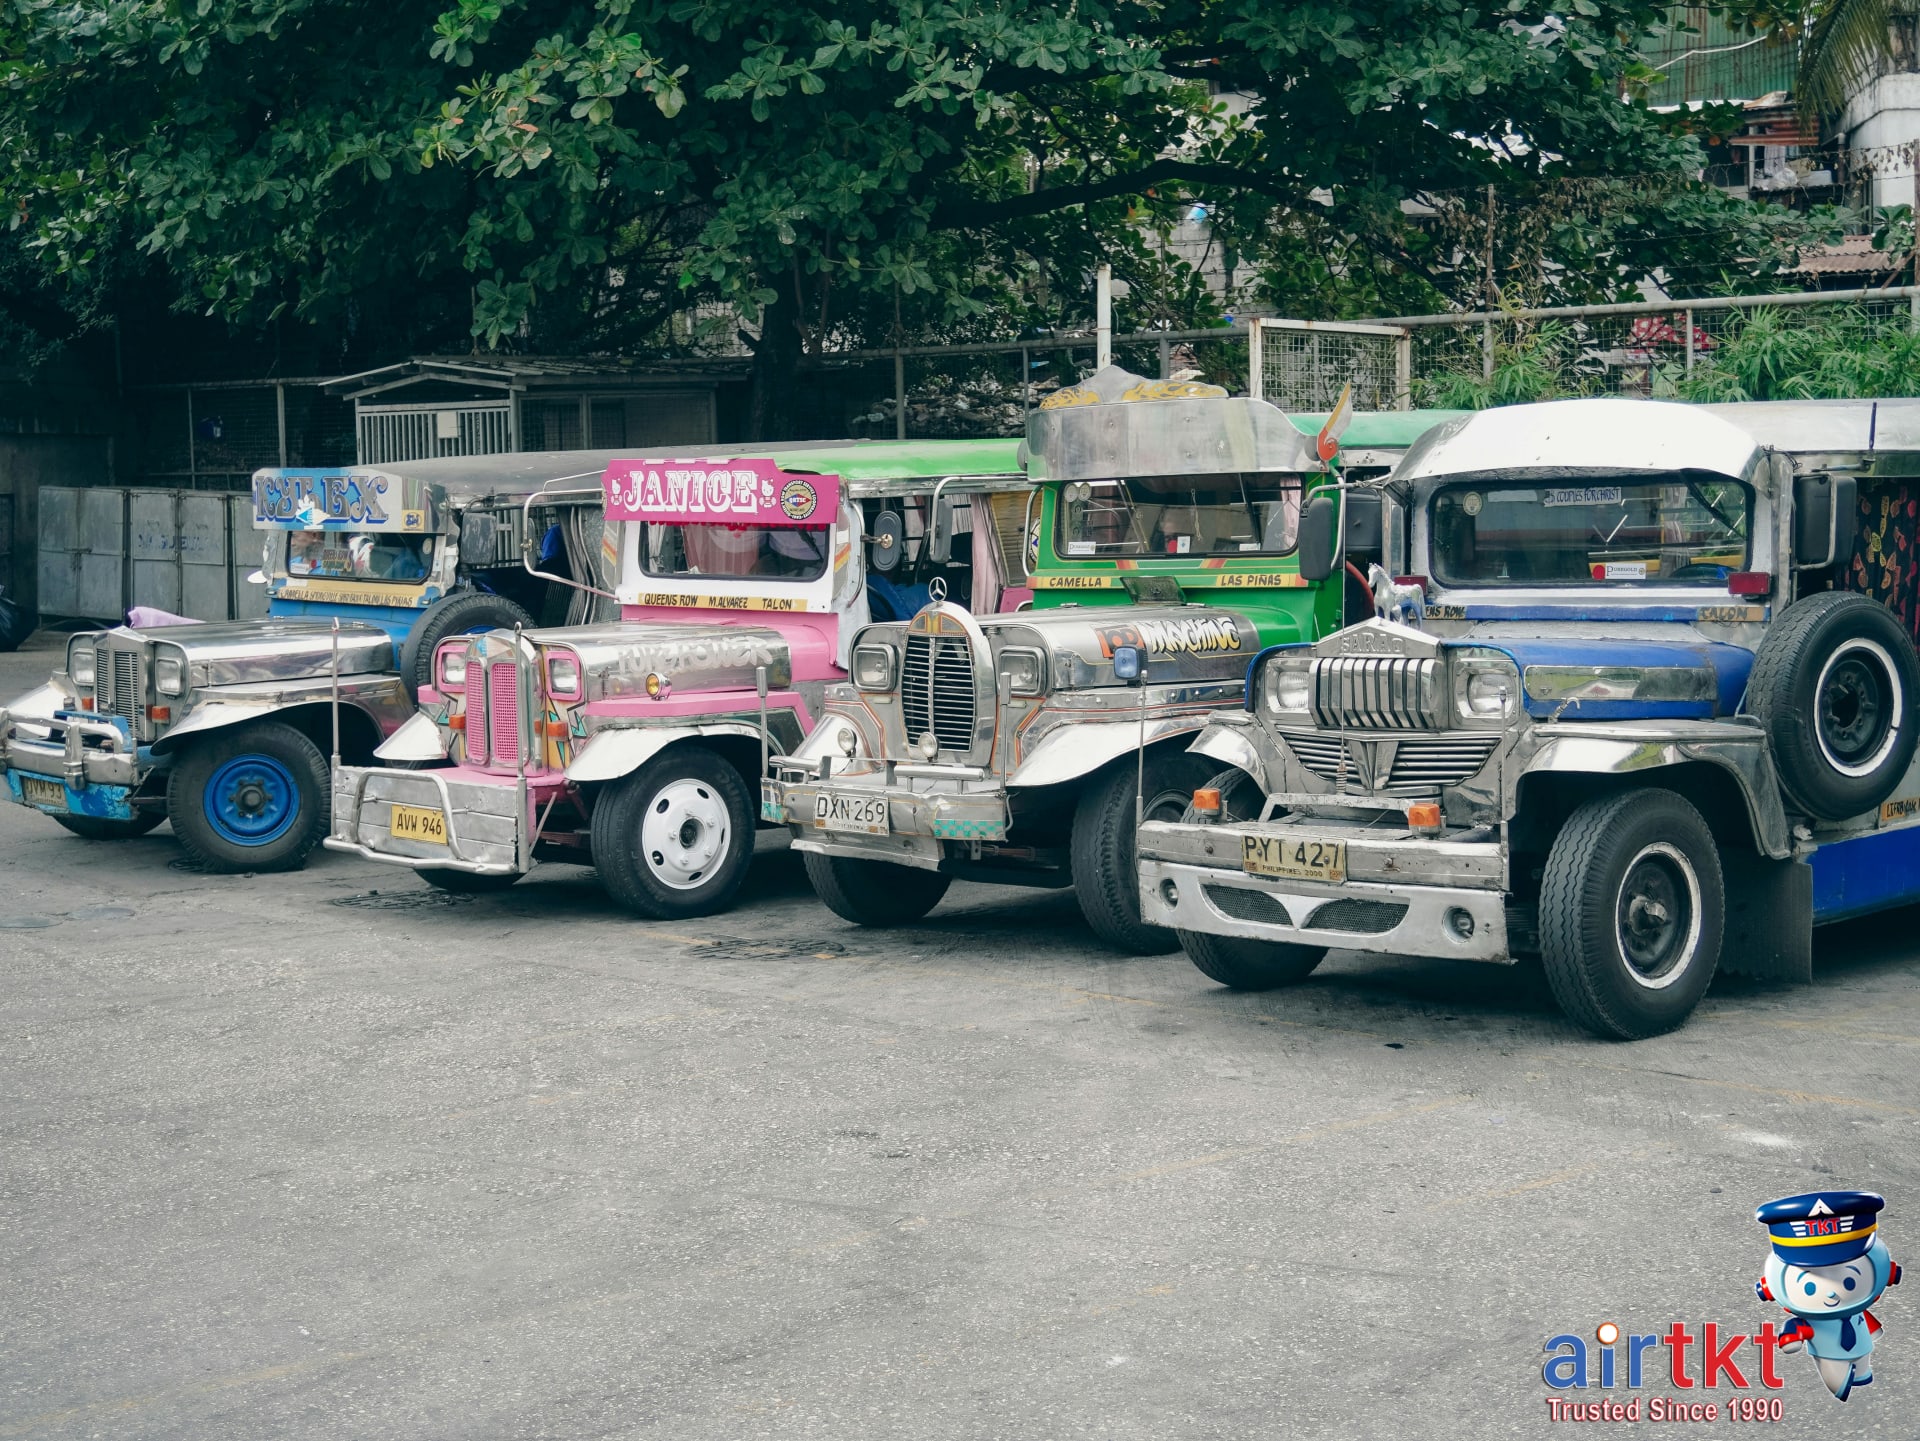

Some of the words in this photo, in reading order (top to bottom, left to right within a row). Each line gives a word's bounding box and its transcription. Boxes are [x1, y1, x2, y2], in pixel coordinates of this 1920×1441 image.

[624, 471, 758, 513] JANICE
[1049, 577, 1102, 587] CAMELLA
[1221, 575, 1242, 586] LAS
[644, 594, 678, 606] QUEENS
[680, 595, 699, 607] ROW
[708, 596, 749, 609] M.ALVAREZ
[762, 598, 792, 610] TALON
[817, 796, 850, 820] DXN
[854, 800, 885, 824] 269
[396, 813, 418, 832] AVW
[422, 816, 442, 836] 946
[1244, 835, 1286, 864] PYT
[1295, 841, 1339, 868] 427
[1262, 864, 1301, 876] PHILIPPINES
[1304, 869, 1323, 877] 2000
